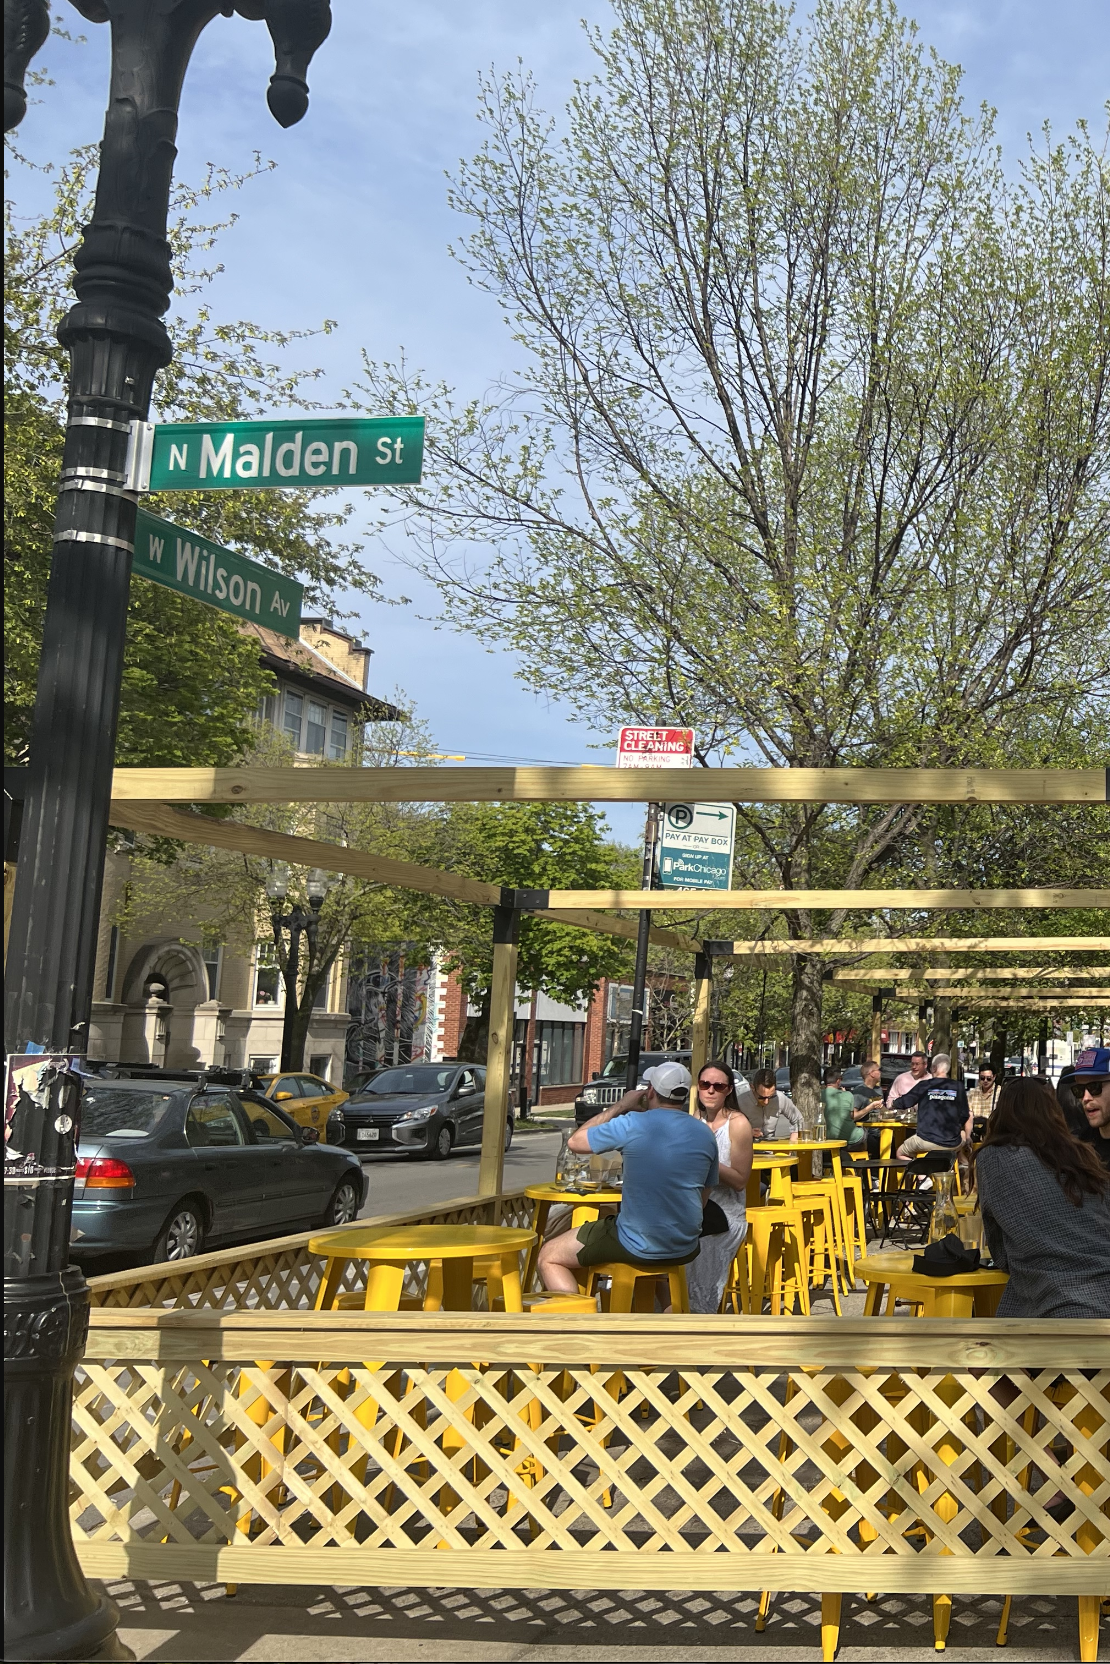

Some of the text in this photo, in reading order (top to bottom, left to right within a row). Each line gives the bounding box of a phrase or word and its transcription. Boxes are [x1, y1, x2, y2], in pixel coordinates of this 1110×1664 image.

[169, 431, 404, 479] N Malden St
[150, 534, 290, 618] W Wilson Av
[625, 730, 668, 741] STREET
[623, 741, 684, 752] CLEANING
[638, 755, 671, 763] PARKING
[665, 832, 728, 846] PAY AT PAY BOX
[673, 861, 726, 878] ParkChicago
